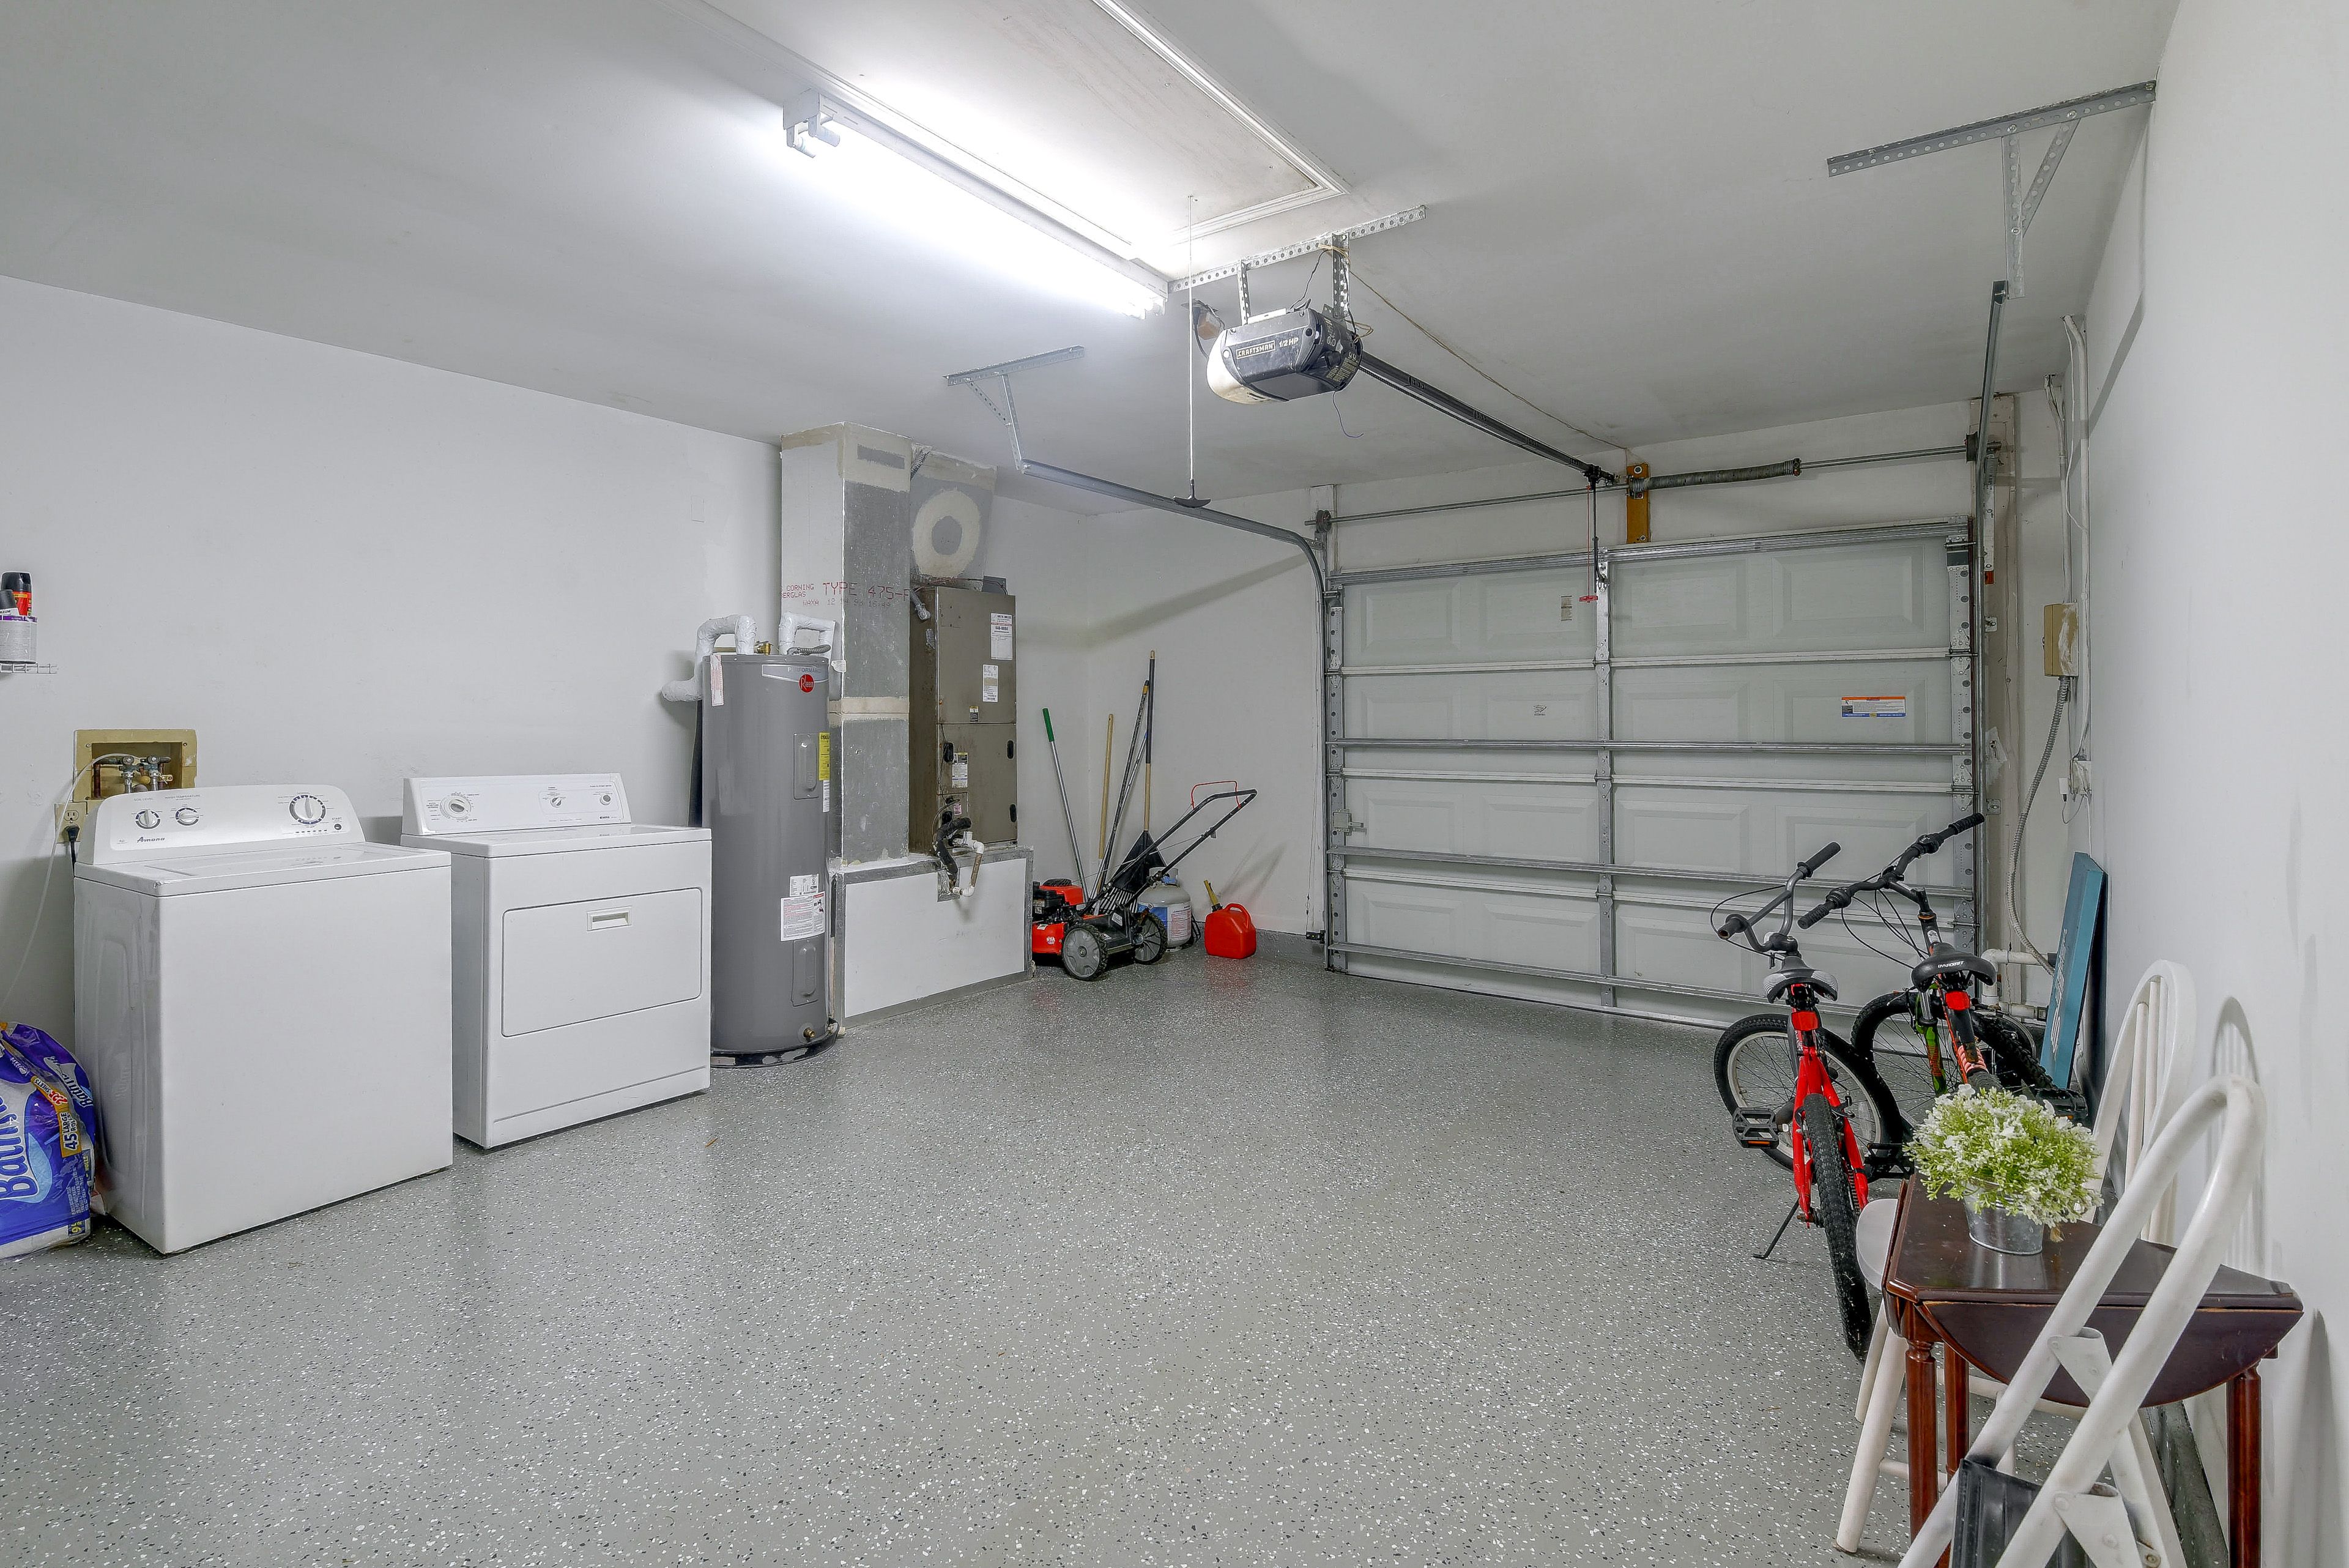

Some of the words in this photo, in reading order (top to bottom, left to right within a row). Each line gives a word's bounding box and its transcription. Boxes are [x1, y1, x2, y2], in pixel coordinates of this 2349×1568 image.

[1237, 343, 1274, 357] CRAFTSMAN
[1288, 337, 1299, 346] HP
[786, 583, 815, 592] CORNING
[822, 581, 858, 596] TYPE
[34, 1078, 51, 1093] SHEETS
[61, 1112, 69, 1134] LARGE
[64, 1132, 78, 1150] 45
